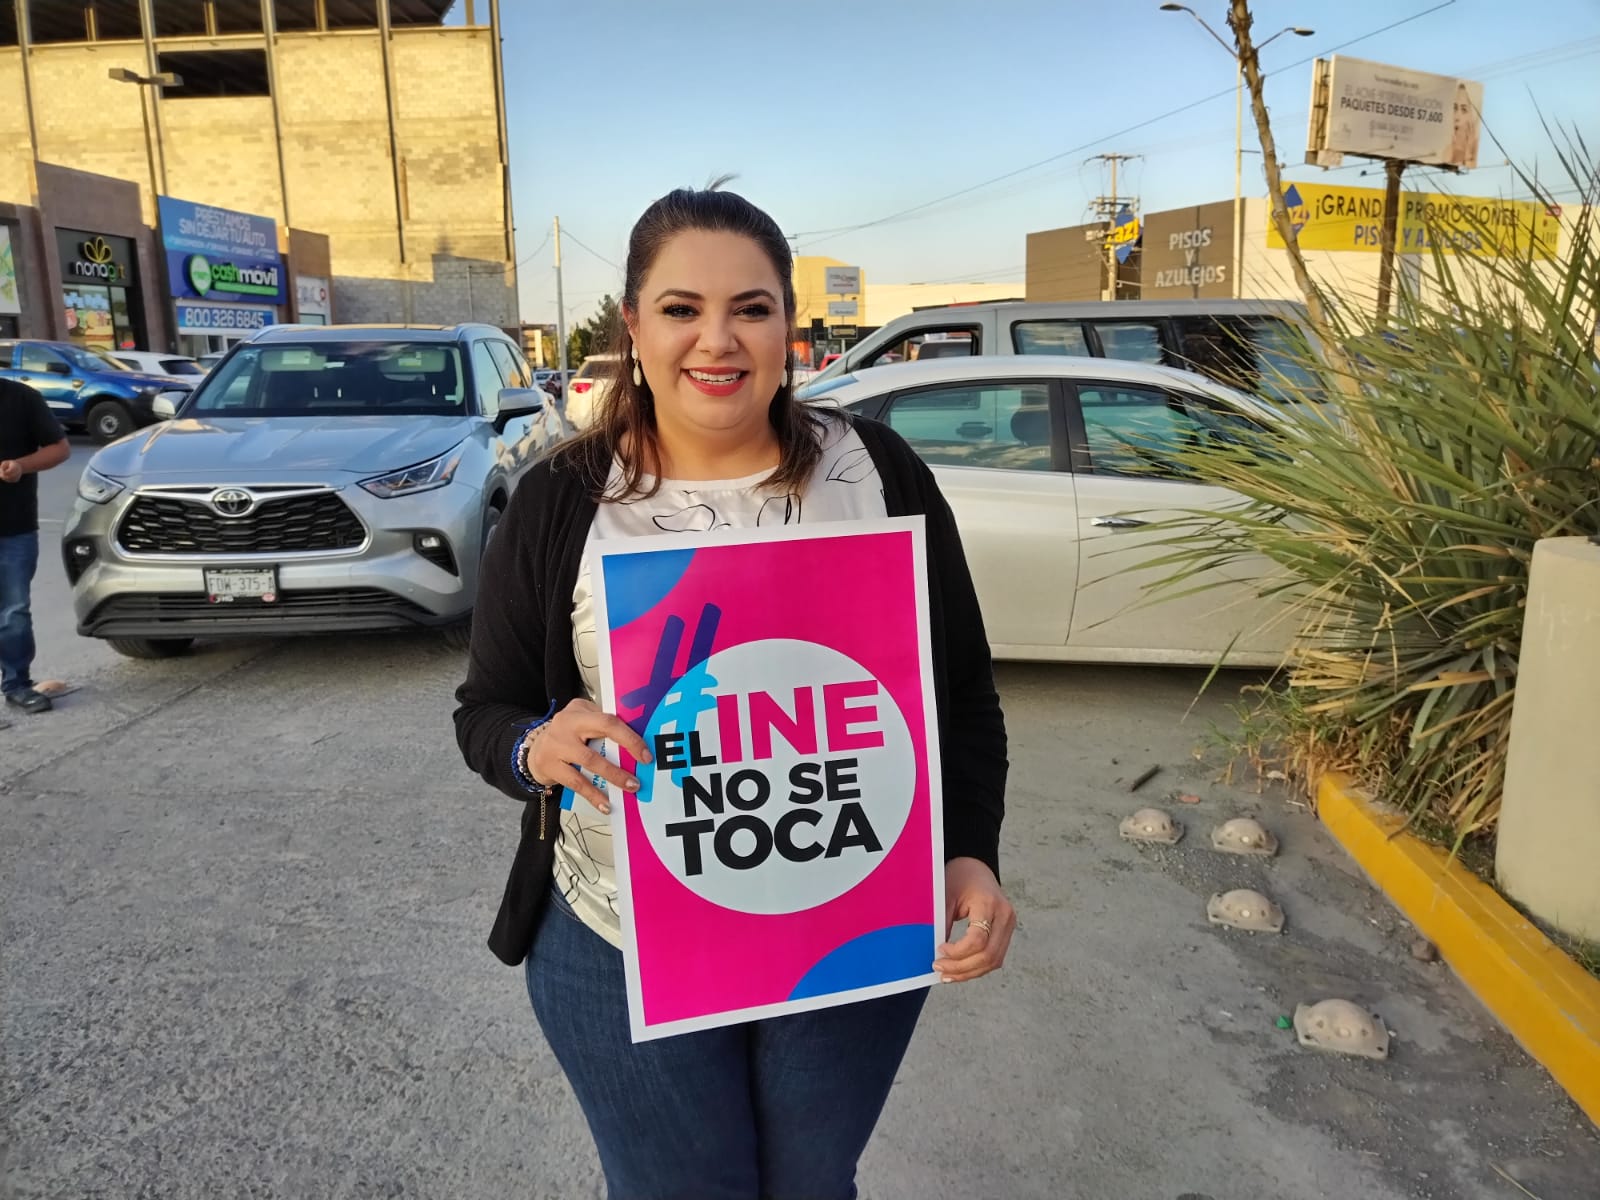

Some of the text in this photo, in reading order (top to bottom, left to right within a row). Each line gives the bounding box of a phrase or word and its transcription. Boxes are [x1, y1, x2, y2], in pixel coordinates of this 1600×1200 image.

[1340, 97, 1387, 114] PAQUETES
[1388, 104, 1415, 119] DESDE
[1315, 194, 1388, 221] ¡GRAND
[179, 218, 196, 235] SIN
[196, 222, 229, 240] DEJAR
[242, 230, 266, 247] AUTO
[1169, 229, 1212, 250] PISOS
[1353, 224, 1389, 246] PIS
[1402, 227, 1412, 247] Y
[1185, 248, 1195, 267] Y
[1155, 266, 1227, 287] AZULEJOS
[185, 307, 264, 329] 800 326 6845
[653, 731, 717, 771] EL
[716, 680, 885, 764] INE
[682, 758, 861, 818] NO SE
[666, 802, 884, 877] TOCA
